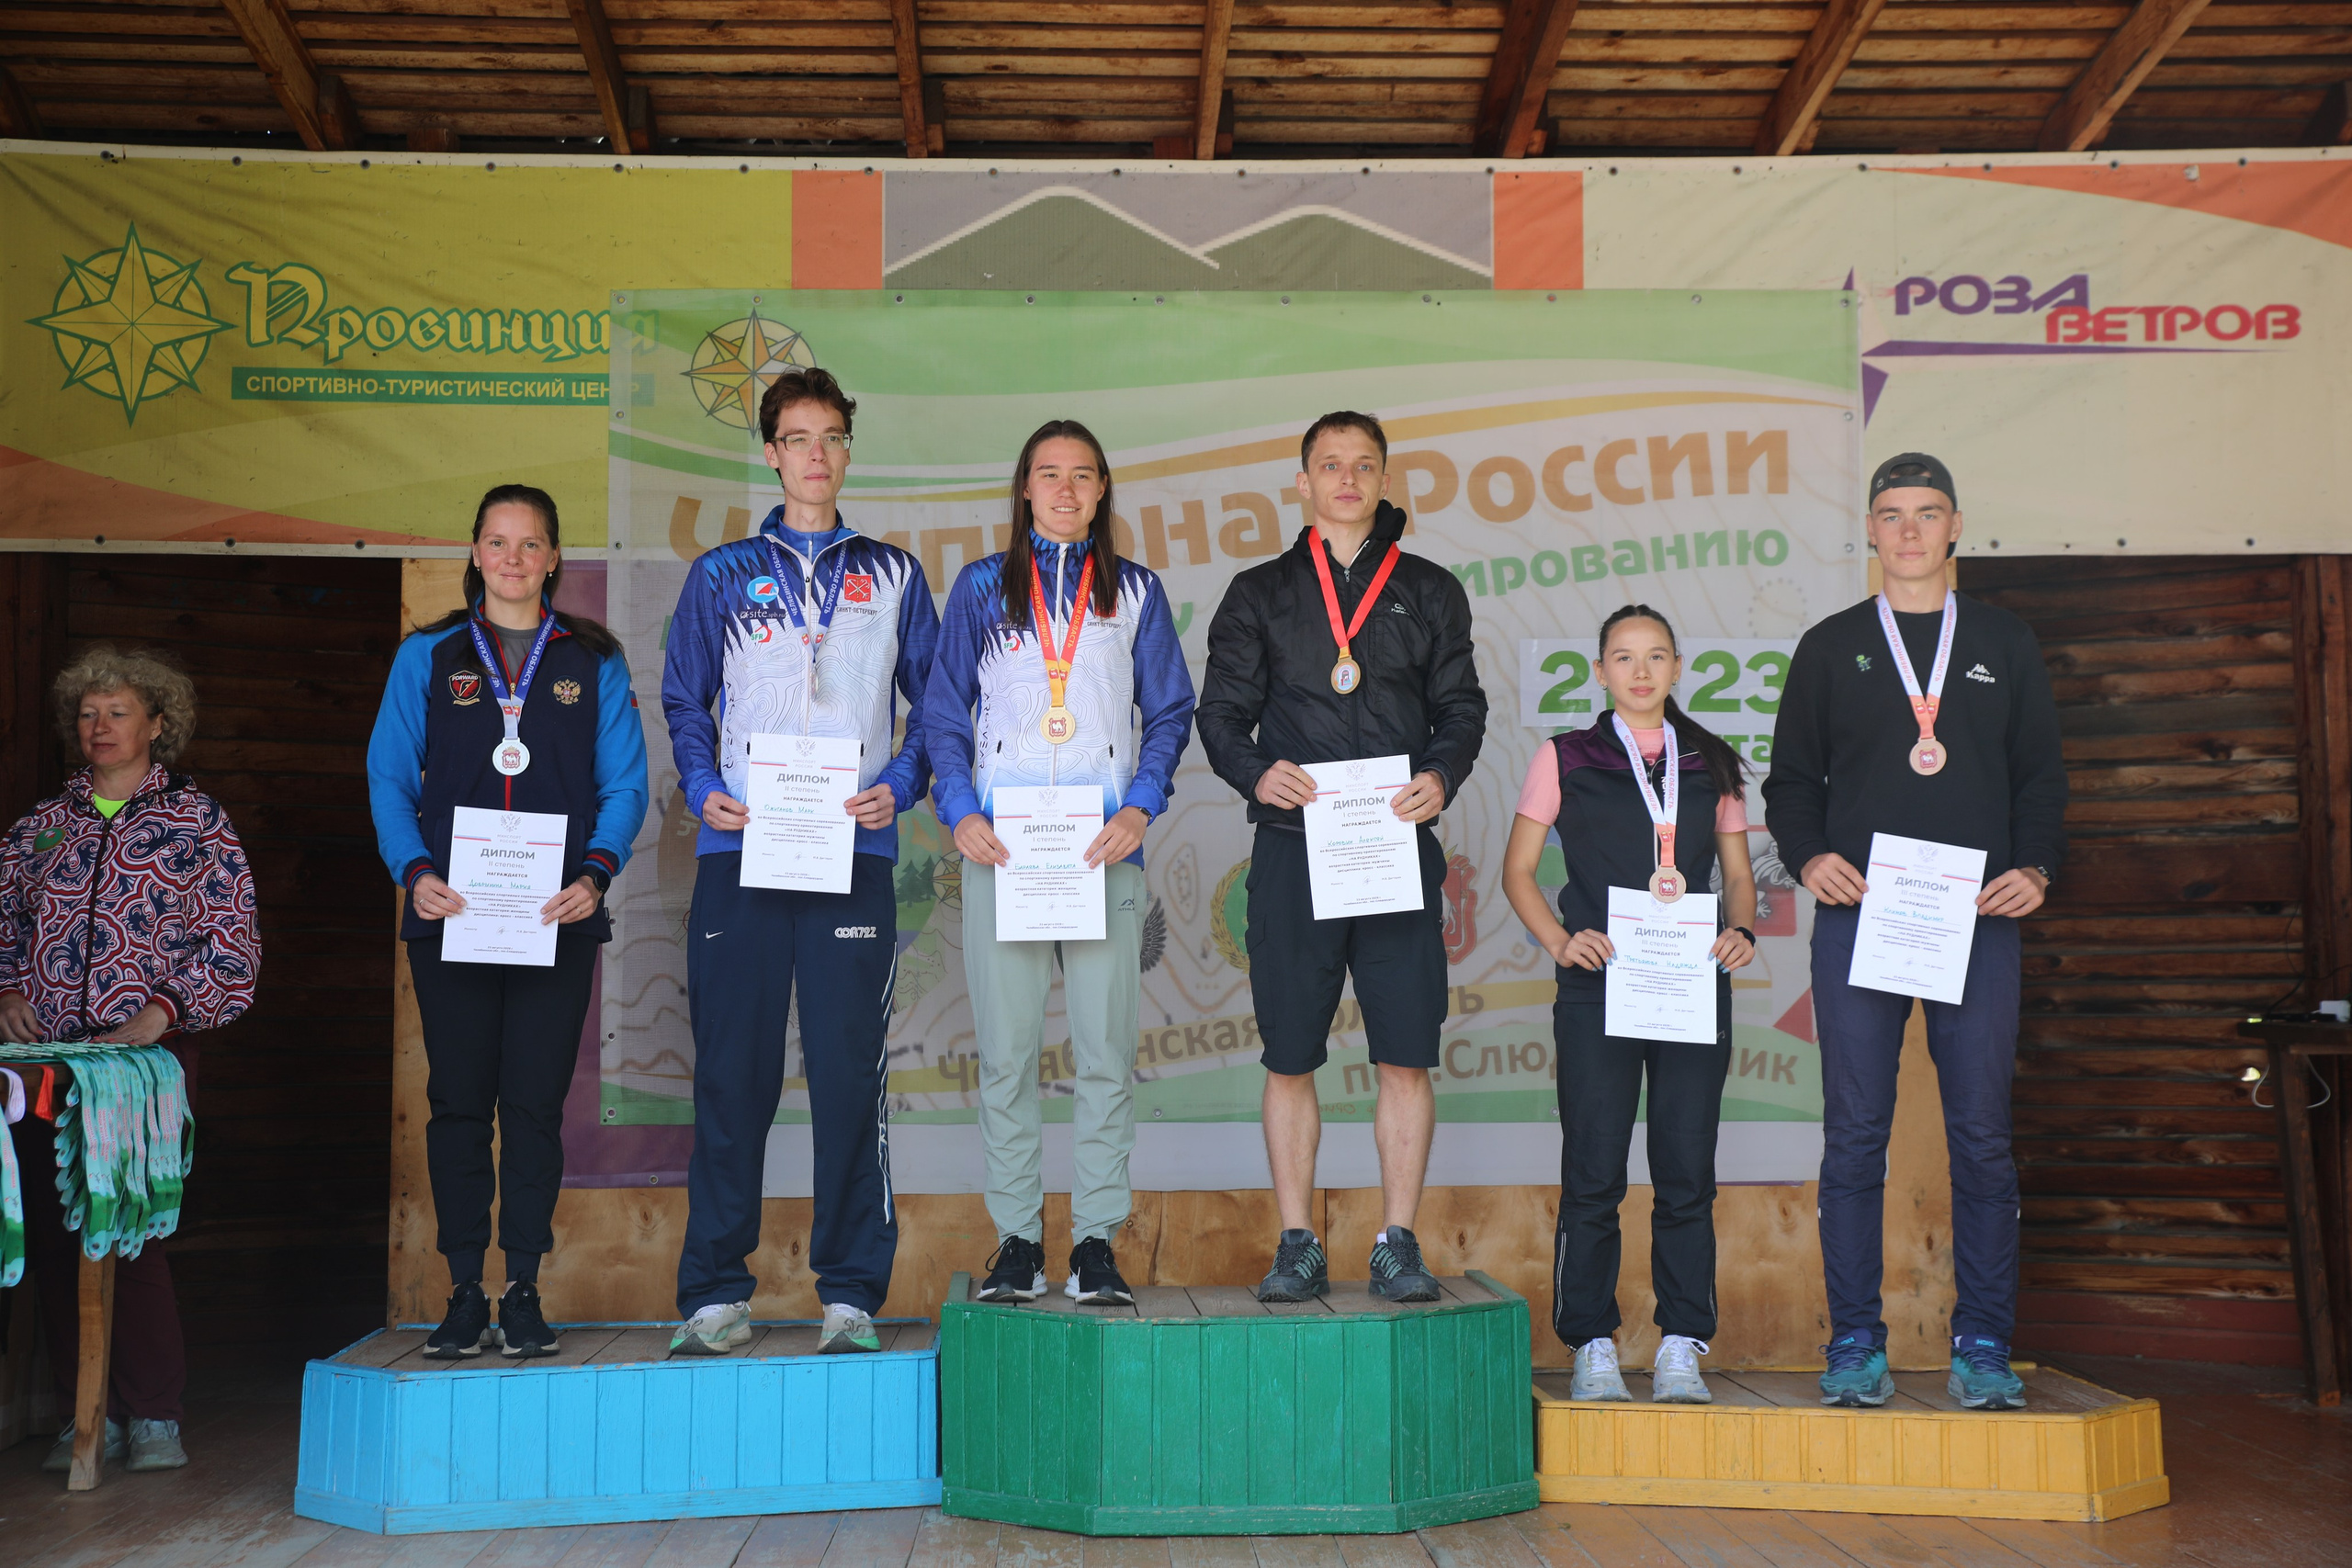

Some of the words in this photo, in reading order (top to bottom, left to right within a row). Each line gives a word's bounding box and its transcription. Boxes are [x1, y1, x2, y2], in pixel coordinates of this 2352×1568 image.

[1894, 274, 2089, 315] РОЗА
[225, 261, 660, 366] Провинция
[2045, 304, 2302, 344] ВЕТРОВ
[245, 372, 566, 398] СПОРТИВНО-ТУРИСТИЧЕСКИЙ
[1385, 429, 1789, 536] России
[1077, 566, 1091, 614] ЧЕЛЯБИНСКАЯ
[1068, 615, 1080, 649] ОБЛАСТЬ
[1537, 649, 1792, 714] 223
[1966, 671, 1996, 683] Kappa
[776, 773, 829, 785] ДИПЛОМ
[1332, 796, 1385, 809] ДИПЛОМ
[1023, 824, 1075, 833] ДИПЛОМ
[480, 848, 535, 860] ДИПЛОМ
[1894, 876, 1949, 893] ДИПЛОМ
[1899, 899, 1939, 909] НАГРАЖДАЕТСЯ
[1634, 927, 1686, 939] ДИПЛОМ
